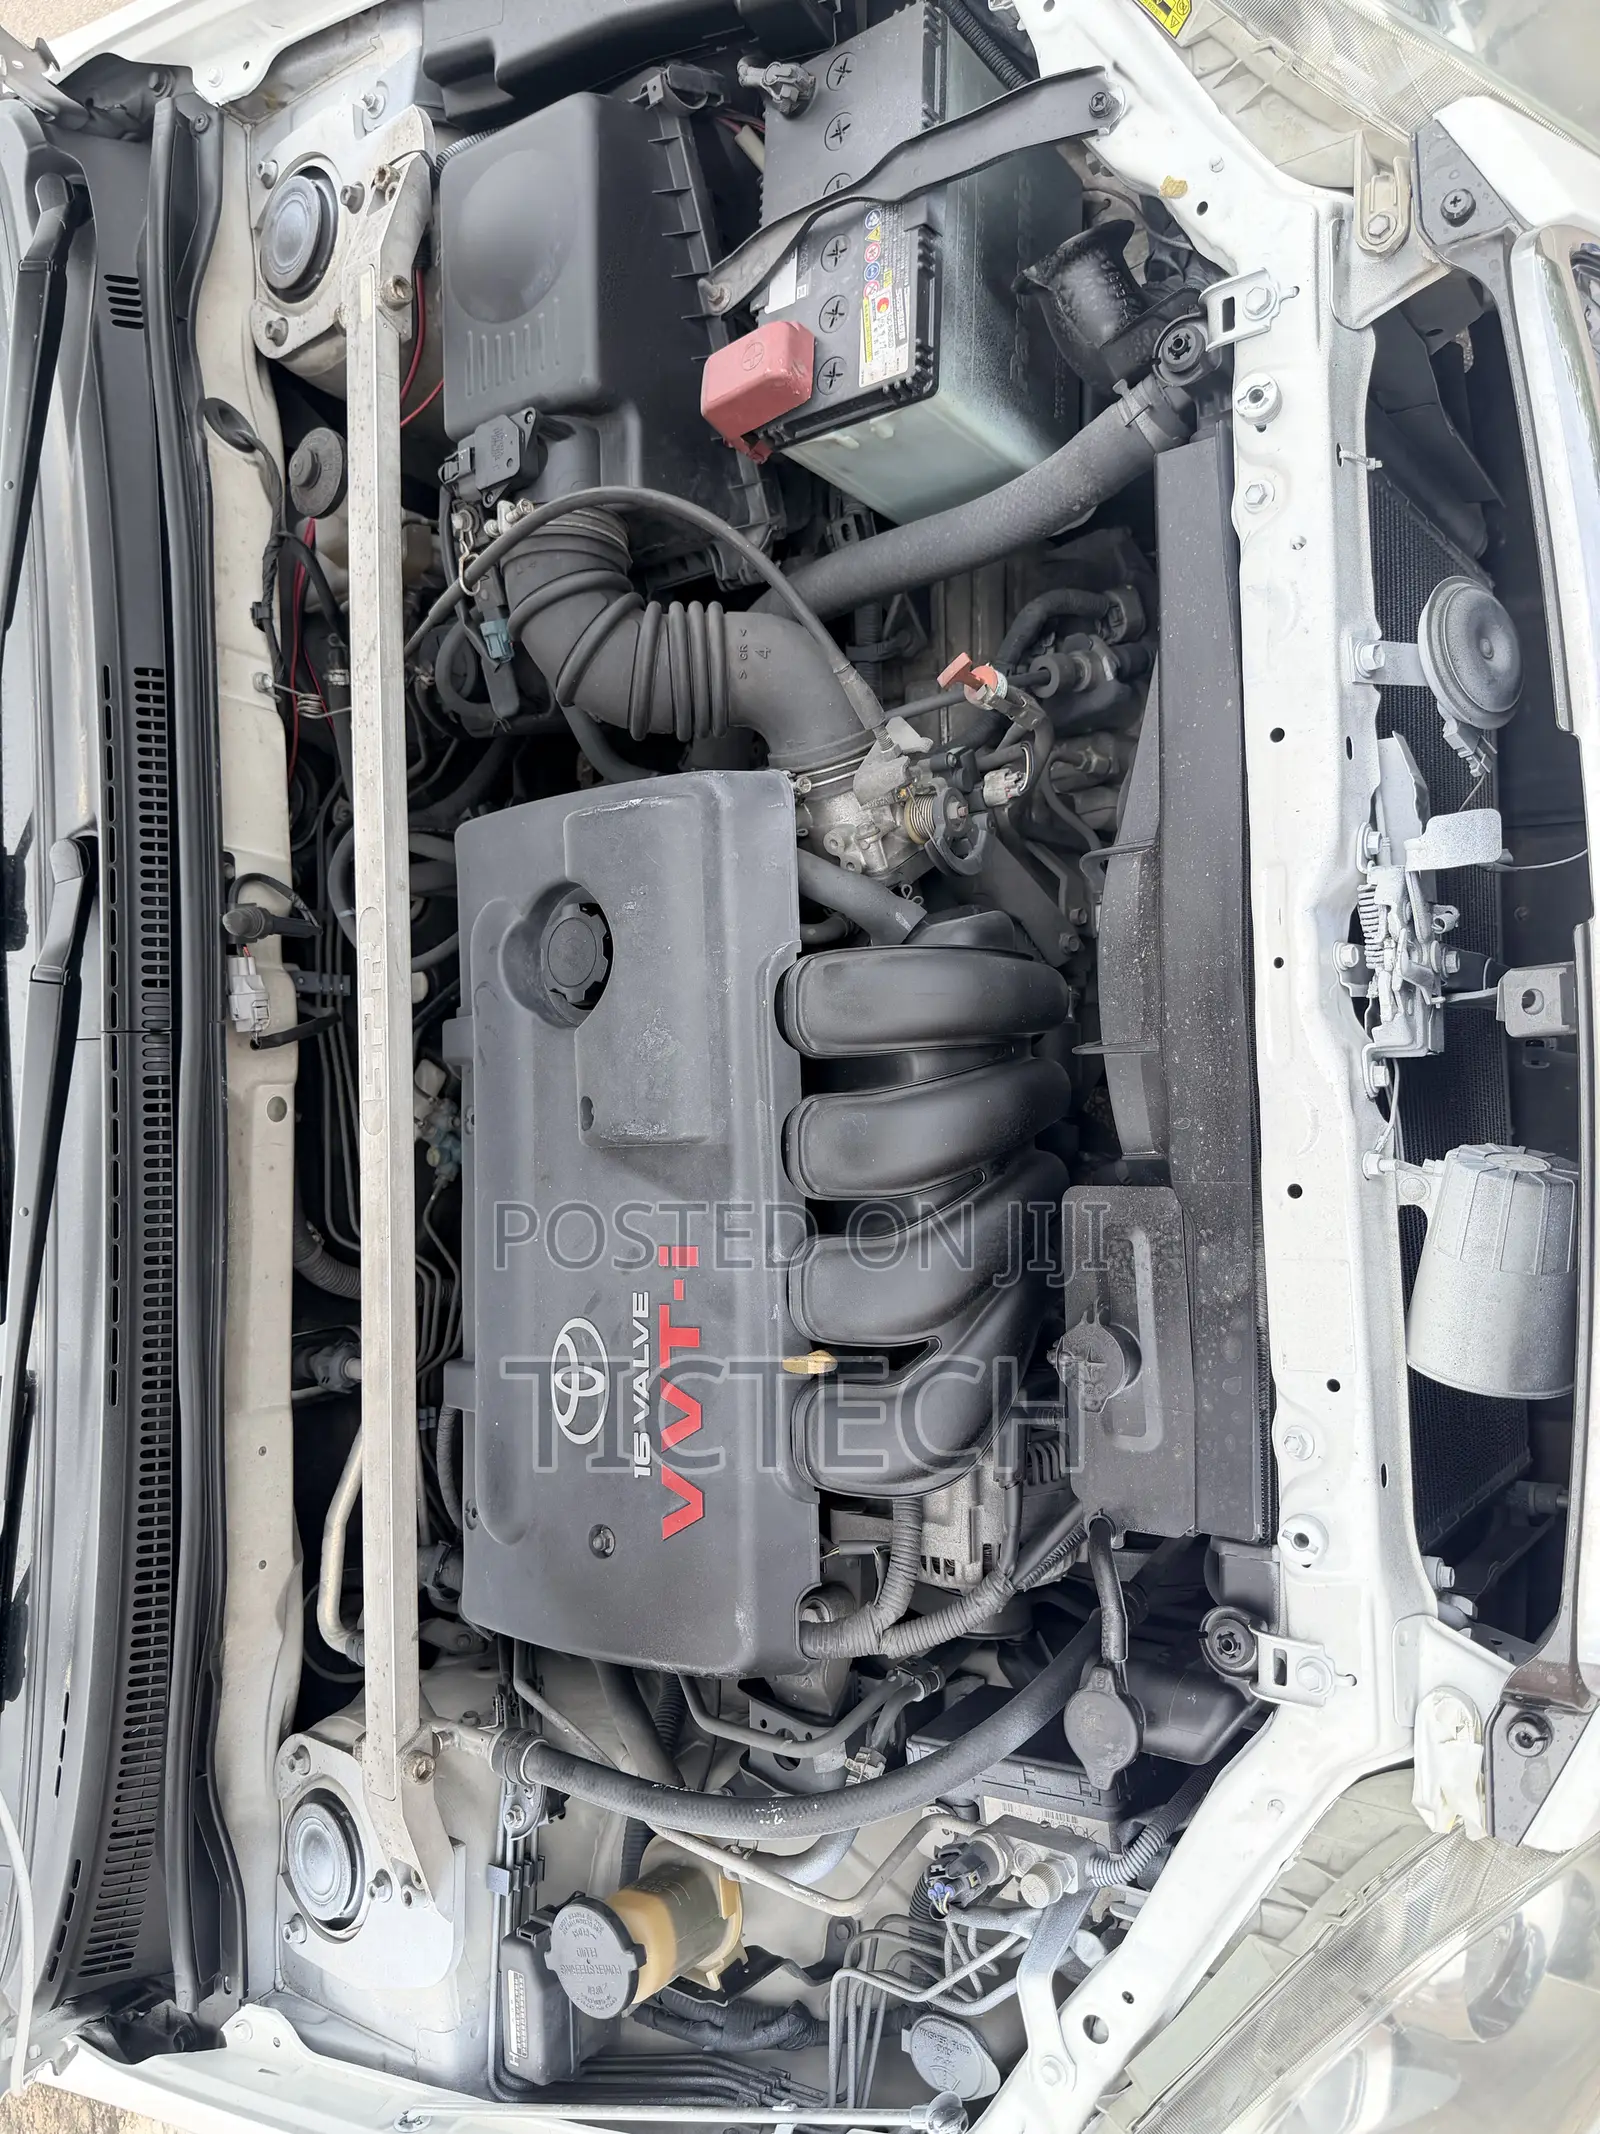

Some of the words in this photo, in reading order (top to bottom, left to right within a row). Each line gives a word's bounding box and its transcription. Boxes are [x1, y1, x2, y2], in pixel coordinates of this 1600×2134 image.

[754, 647, 771, 660] 4
[632, 1290, 651, 1425] VALVE
[658, 1245, 705, 1541] VVT-i
[632, 1430, 651, 1479] 16
